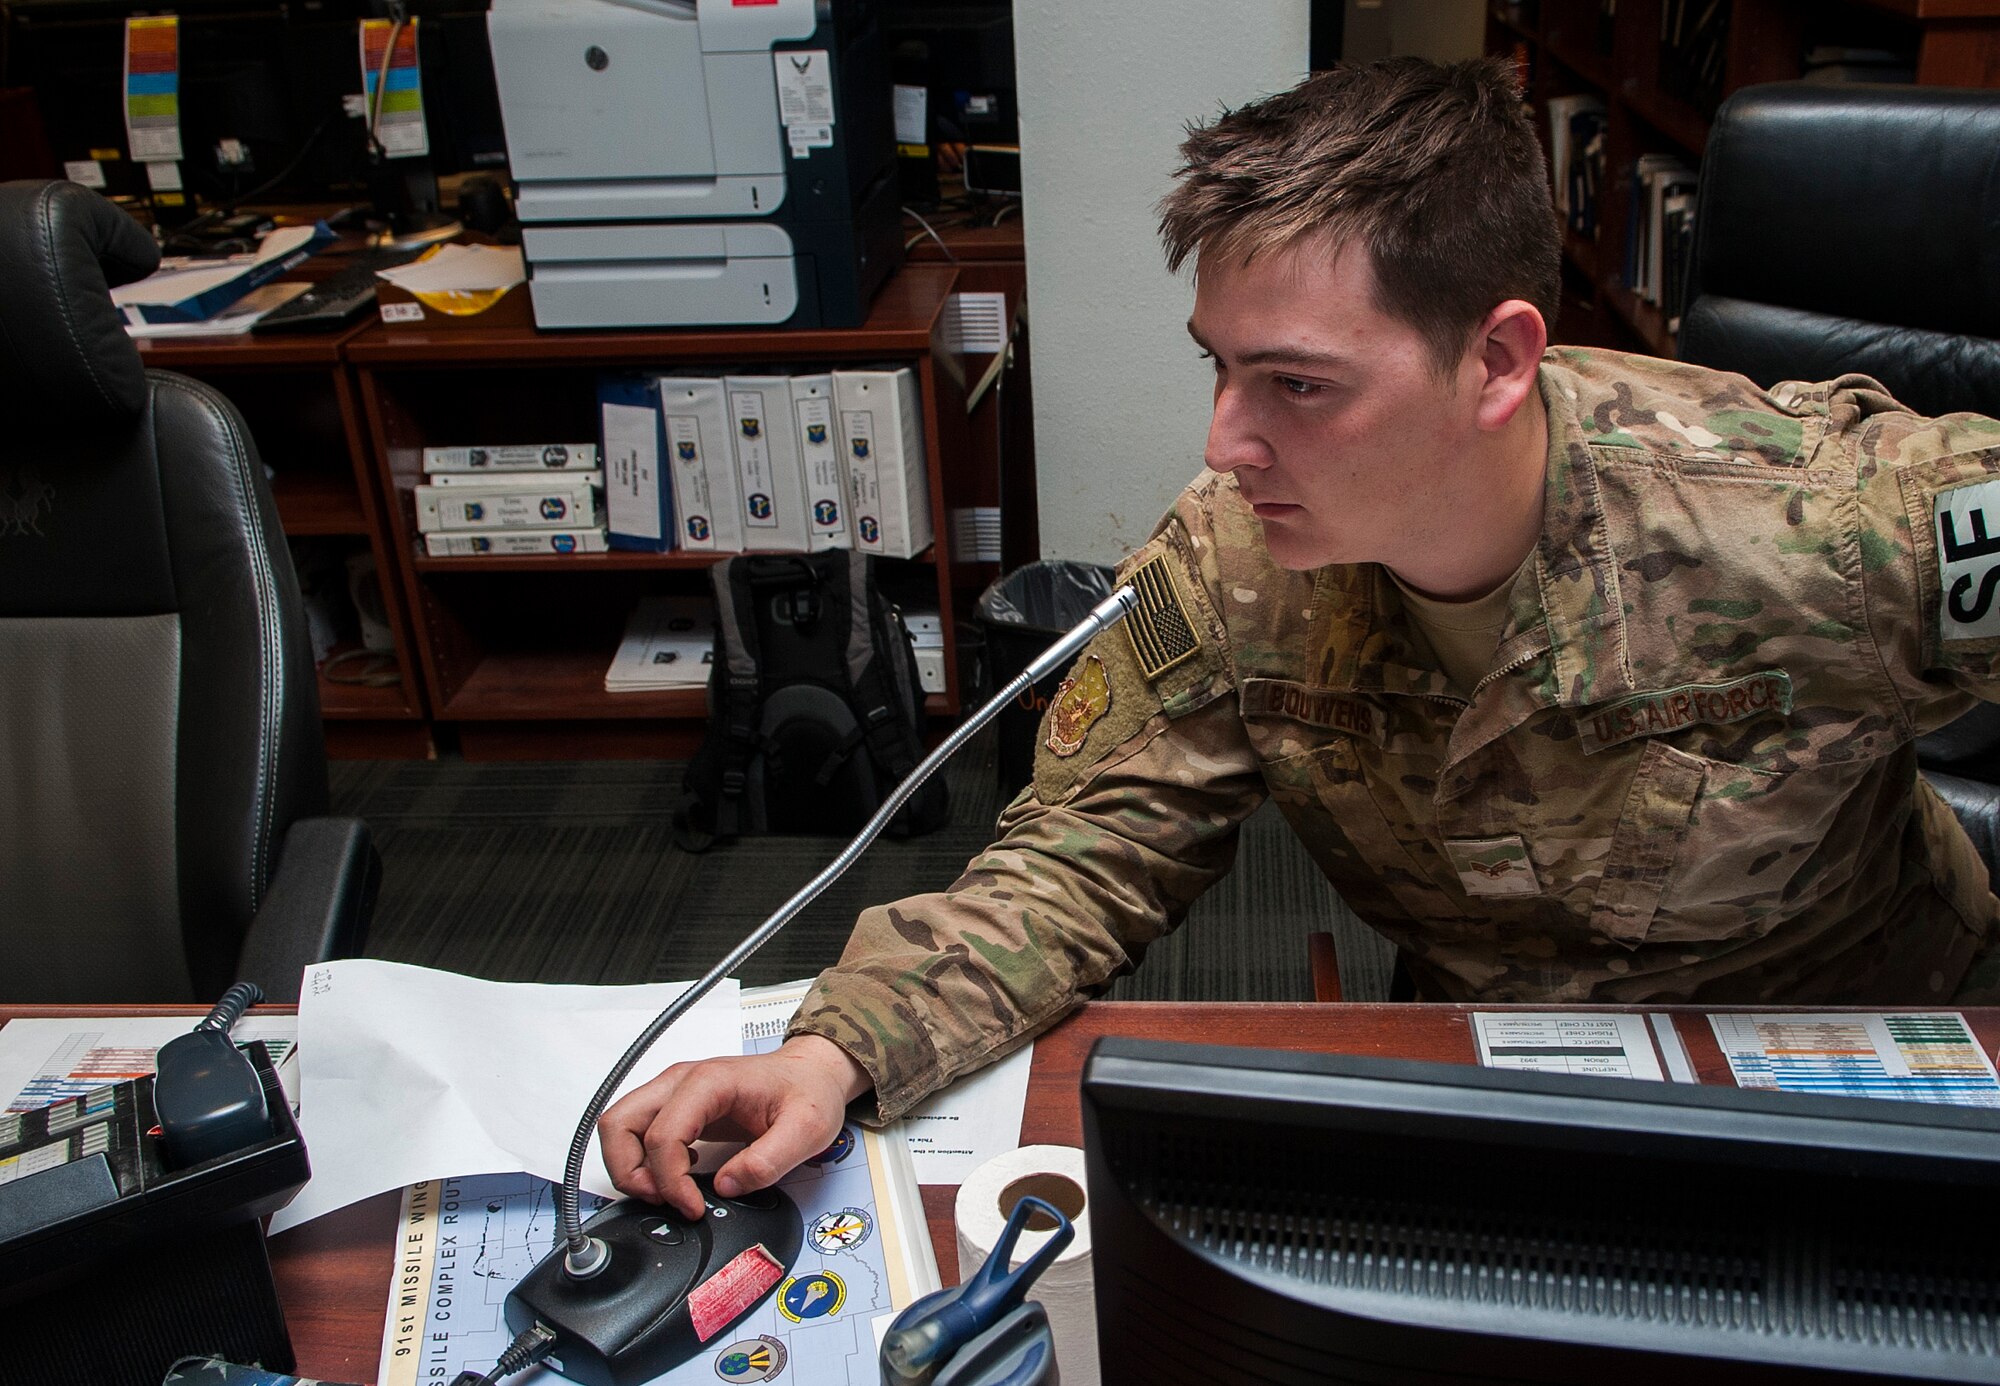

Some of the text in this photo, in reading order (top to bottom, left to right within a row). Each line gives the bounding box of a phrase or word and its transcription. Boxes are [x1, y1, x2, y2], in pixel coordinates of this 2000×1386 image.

[1940, 508, 2000, 624] SF
[1270, 682, 1372, 736] BOUWENS
[1647, 692, 1695, 730] AIR
[1695, 678, 1782, 721] FORCE
[395, 1181, 428, 1356] 91st MISSILE WING
[435, 1235, 457, 1321] COMPLEX
